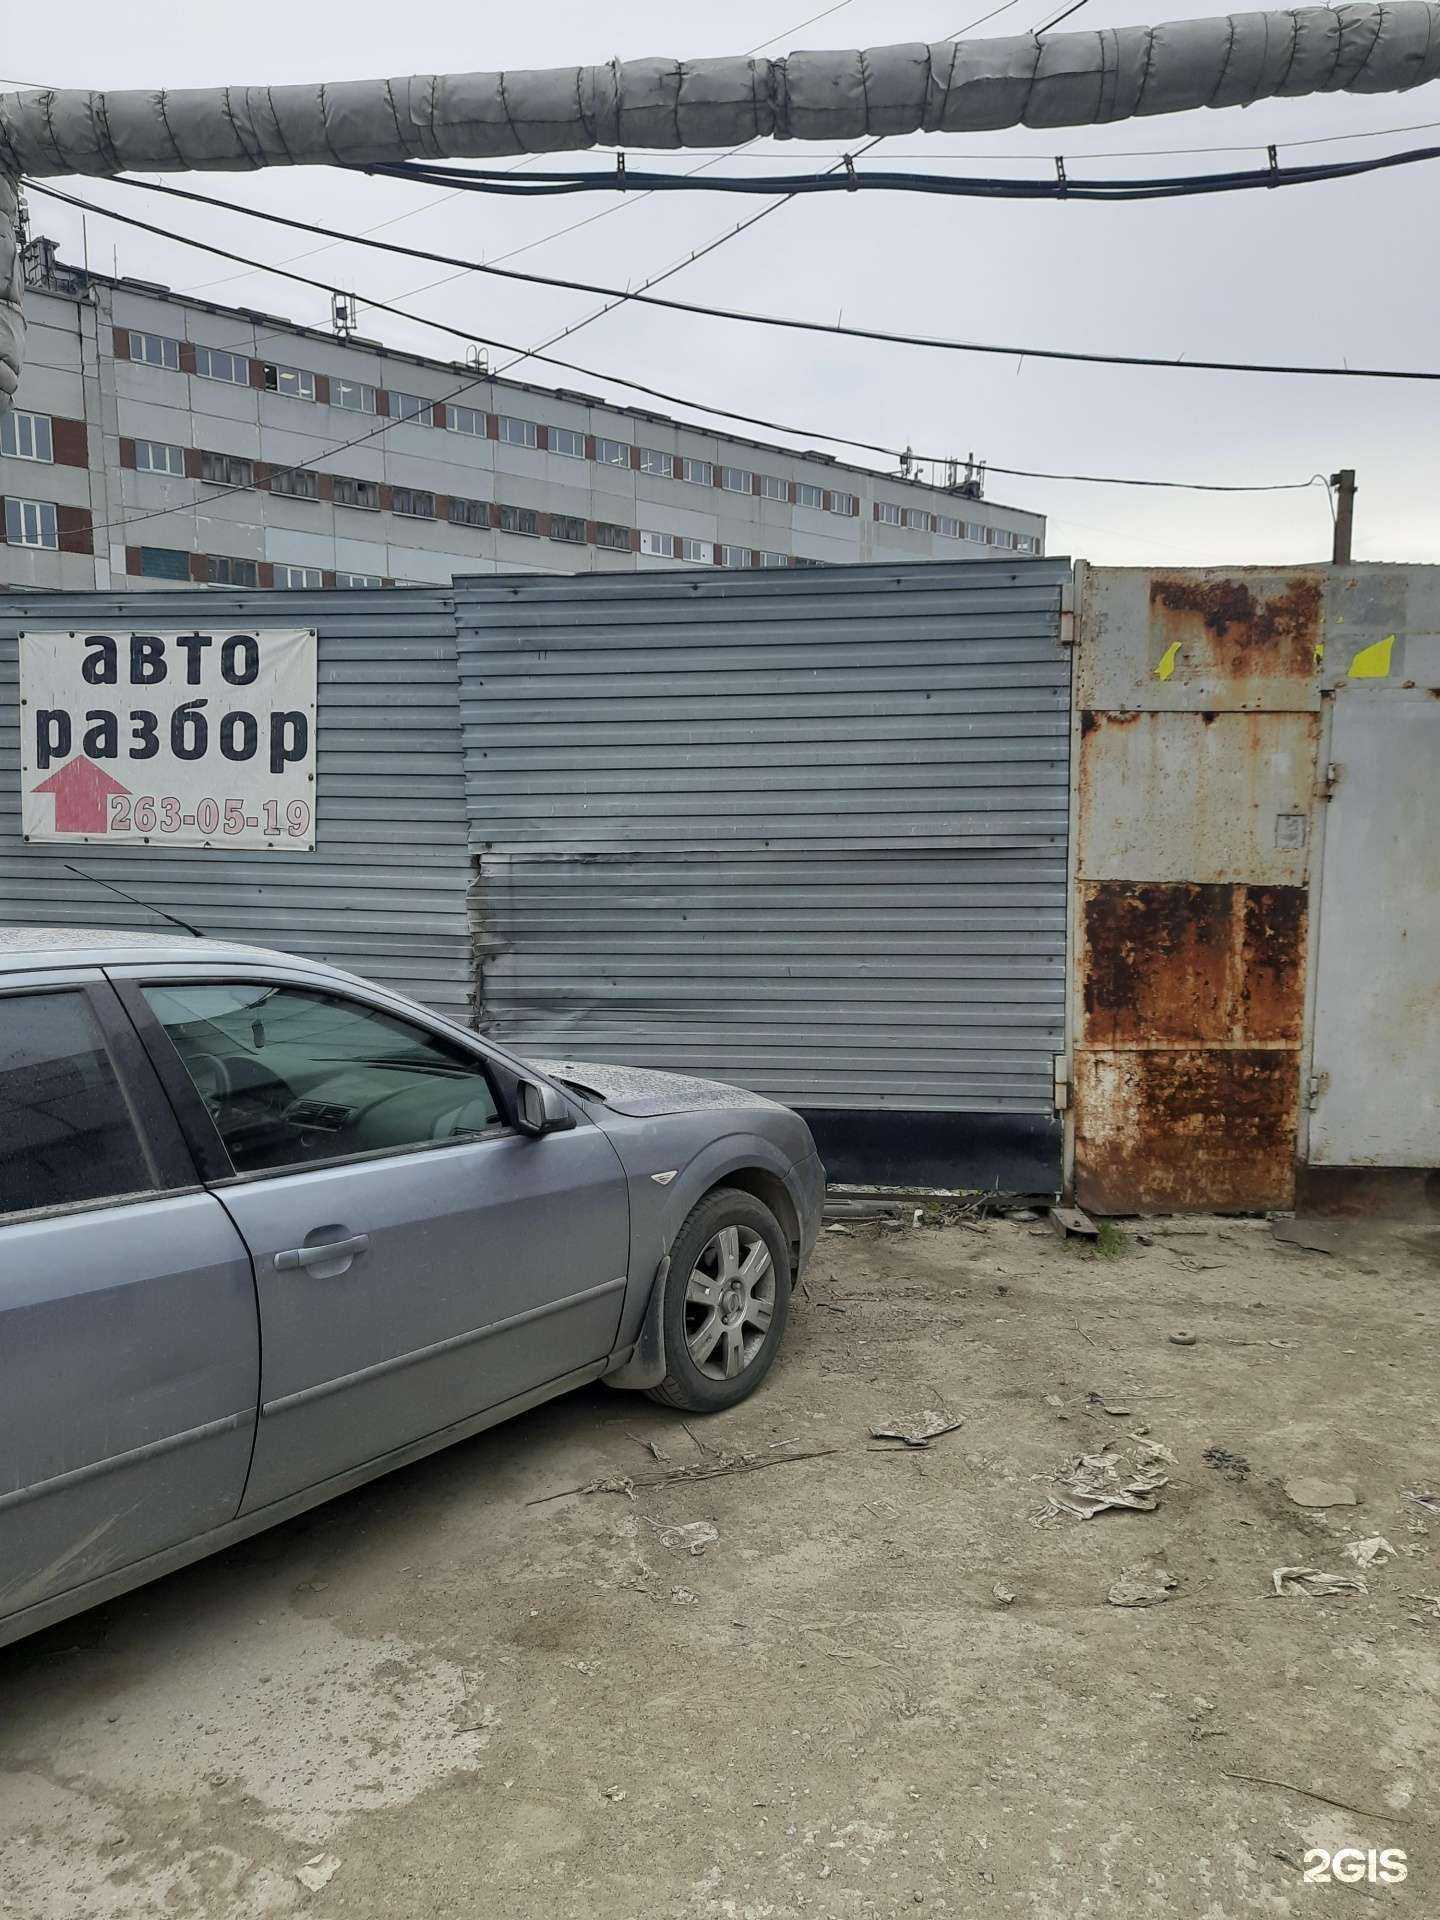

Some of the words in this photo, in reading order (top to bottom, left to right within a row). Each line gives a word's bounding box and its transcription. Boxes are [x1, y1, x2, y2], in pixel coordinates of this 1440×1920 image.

[82, 634, 259, 685] авто
[36, 698, 308, 774] разбор
[110, 795, 311, 837] 263-05-19
